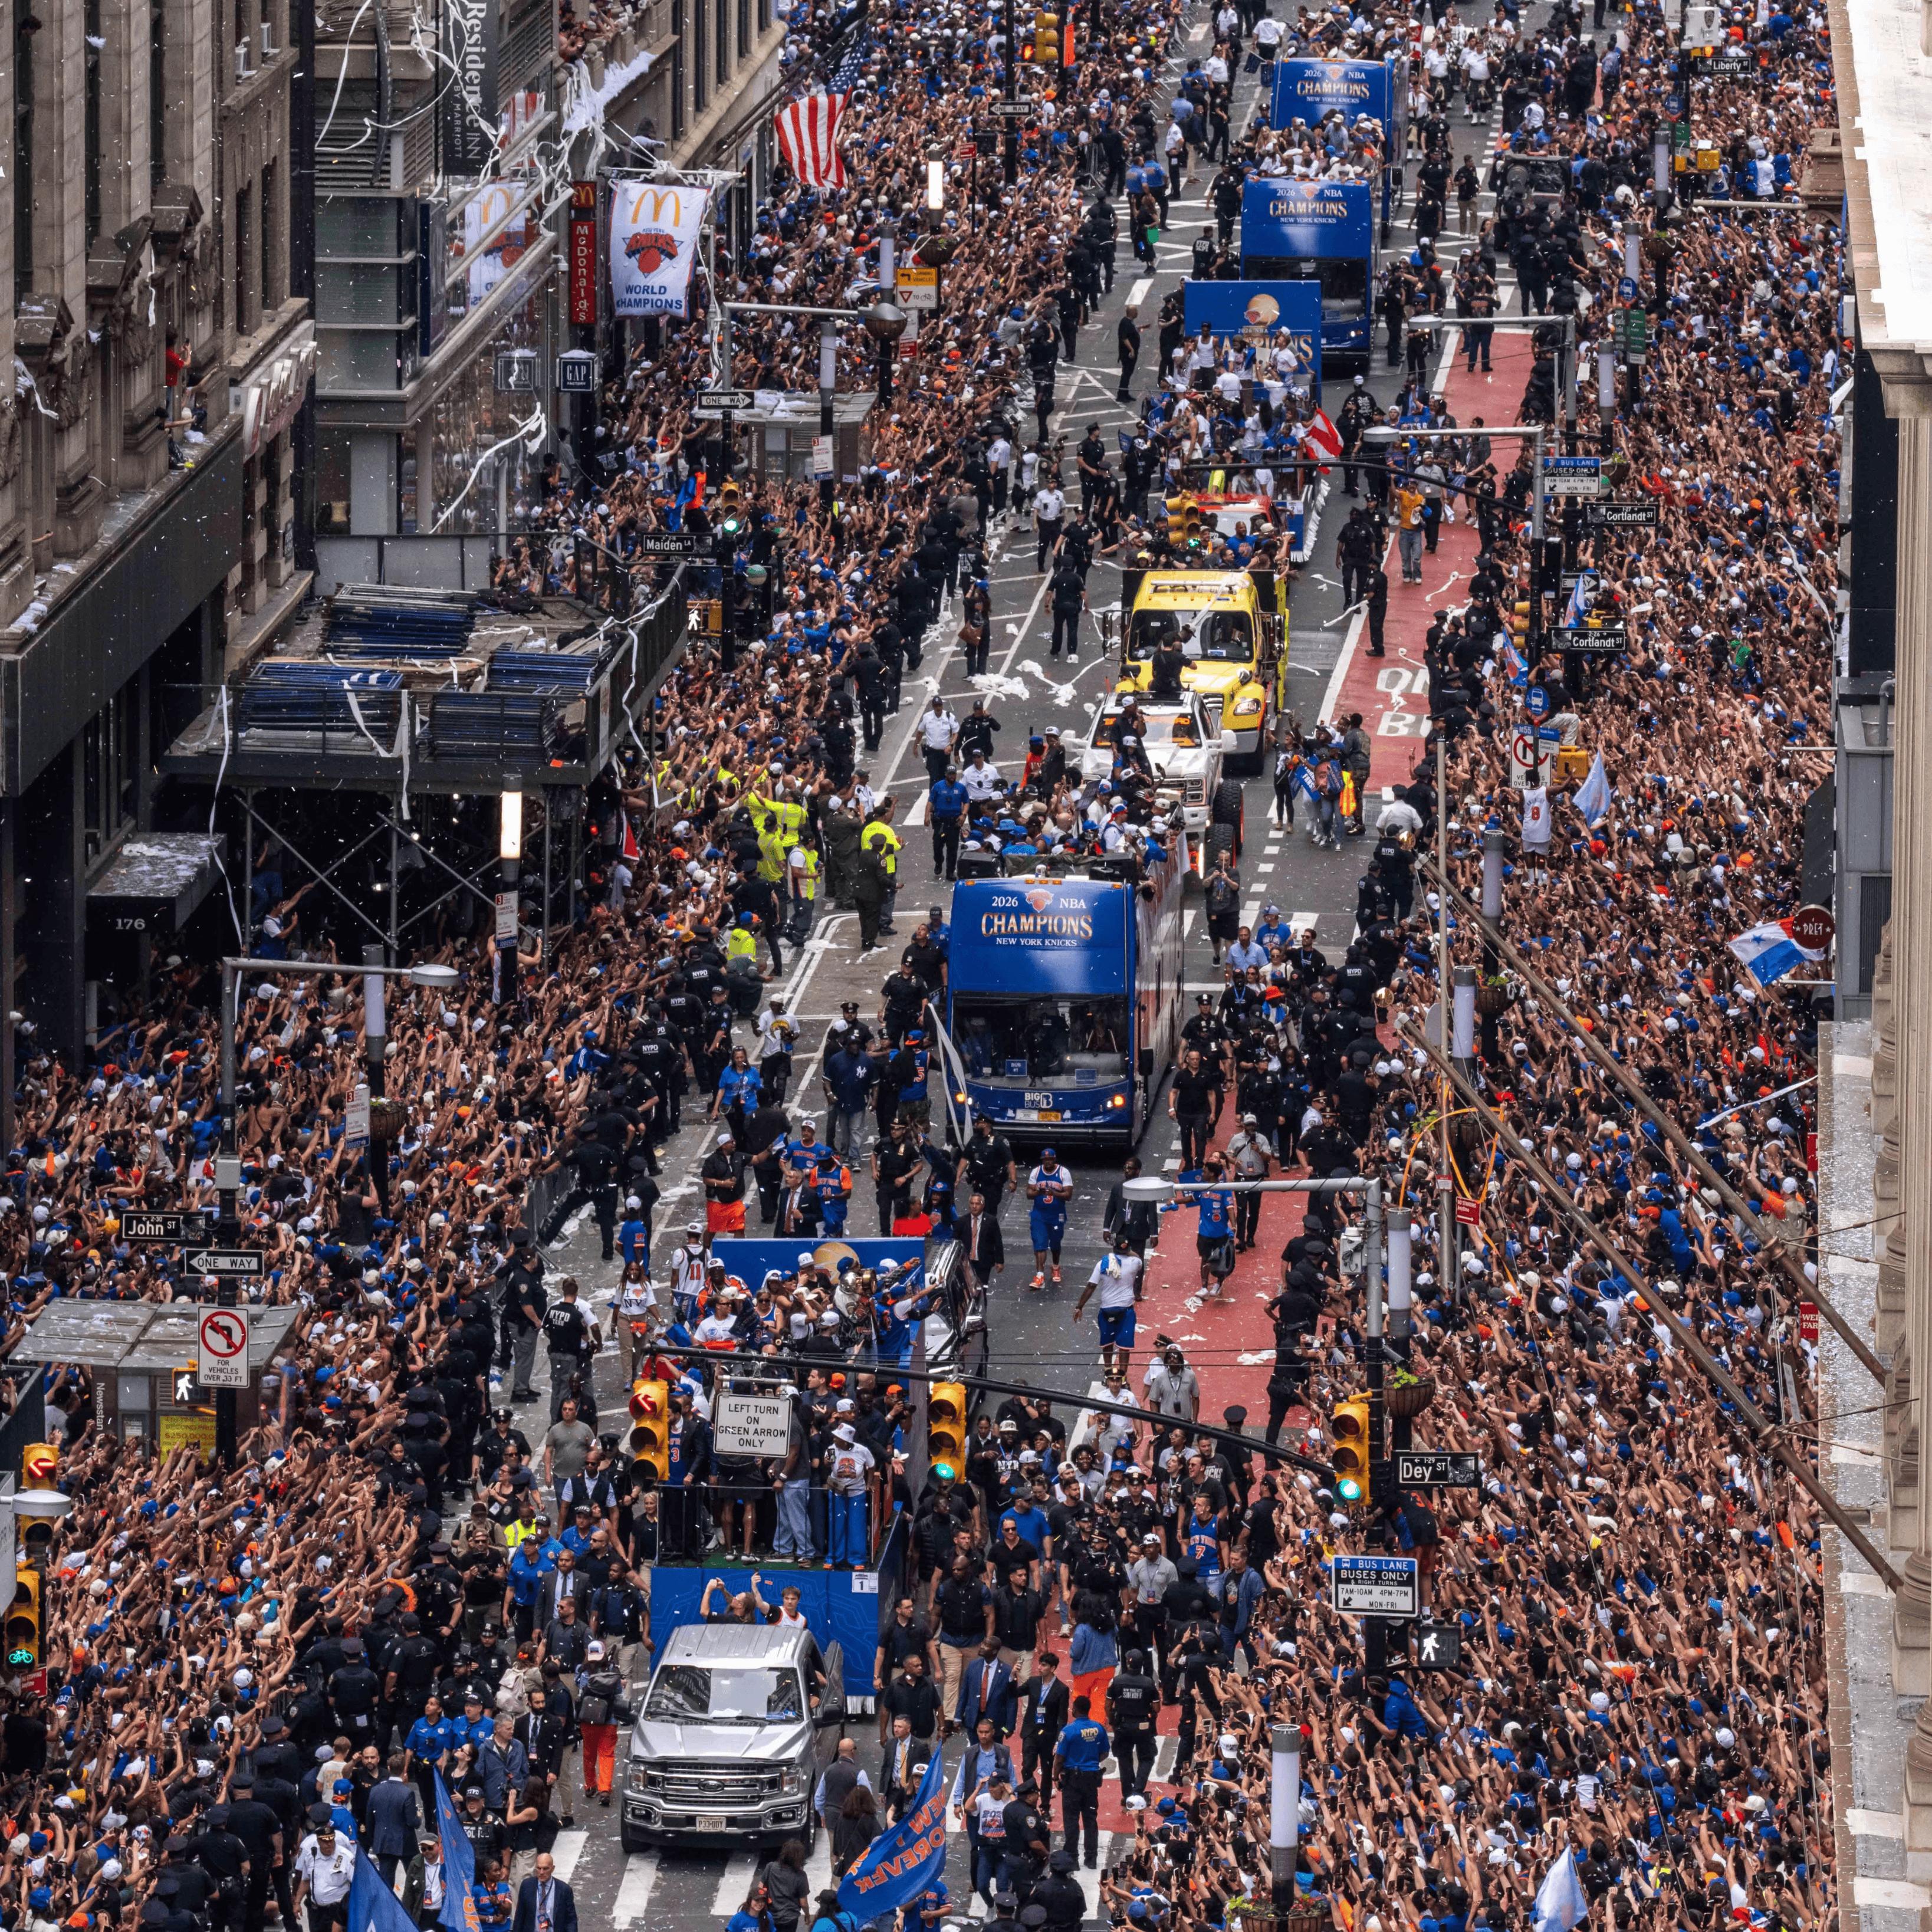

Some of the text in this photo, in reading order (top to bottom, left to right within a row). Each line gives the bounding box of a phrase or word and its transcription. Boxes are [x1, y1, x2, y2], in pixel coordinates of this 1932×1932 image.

[1713, 61, 1742, 72] Liberty
[1348, 71, 1366, 79] NBA
[465, 3, 487, 159] Residence INN
[454, 86, 461, 99] BY
[1297, 81, 1369, 99] CHAMPIONS
[1269, 201, 1348, 218] CHAMPIONS
[625, 285, 668, 295] WORLD
[567, 364, 586, 381] GAP
[728, 396, 746, 406] WAY
[1607, 510, 1647, 521] Cortlandt
[646, 539, 682, 551] Maiden
[1573, 637, 1615, 648] Cortlandt
[497, 896, 502, 905] 3
[991, 896, 1086, 909] 2026 NBA
[116, 918, 146, 930] 176
[981, 912, 1093, 939] CHAMPIONS
[1802, 922, 1822, 935] PRET
[1044, 938, 1077, 947] KNICKS
[692, 970, 708, 978] NYPD
[347, 1092, 353, 1102] 3
[1024, 1100, 1040, 1109] BUS
[128, 1218, 176, 1236] John ST
[197, 1257, 253, 1269] ONE WAY
[690, 1264, 701, 1280] 11
[625, 1288, 630, 1297] I
[623, 1299, 643, 1308] NY
[549, 1309, 571, 1322] NYPD
[216, 1359, 229, 1367] FOR
[728, 1403, 779, 1415] LEFT TURN
[745, 1416, 760, 1425] ON
[718, 1425, 787, 1438] GREEN ARROW
[738, 1438, 765, 1448] ONLY
[671, 1447, 680, 1463] 3
[1402, 1461, 1447, 1483] Dey ST
[1201, 1535, 1217, 1549] YORK
[1195, 1545, 1205, 1559] 7
[1358, 1560, 1409, 1570] BUS LANE
[1340, 1570, 1409, 1581] BUSES ONLY
[859, 1581, 864, 1591] 1
[1340, 1587, 1409, 1598] 7AM-10AM 4PM-7PM
[1369, 1600, 1397, 1609] MON-FRI
[1080, 1727, 1098, 1737] NYPD
